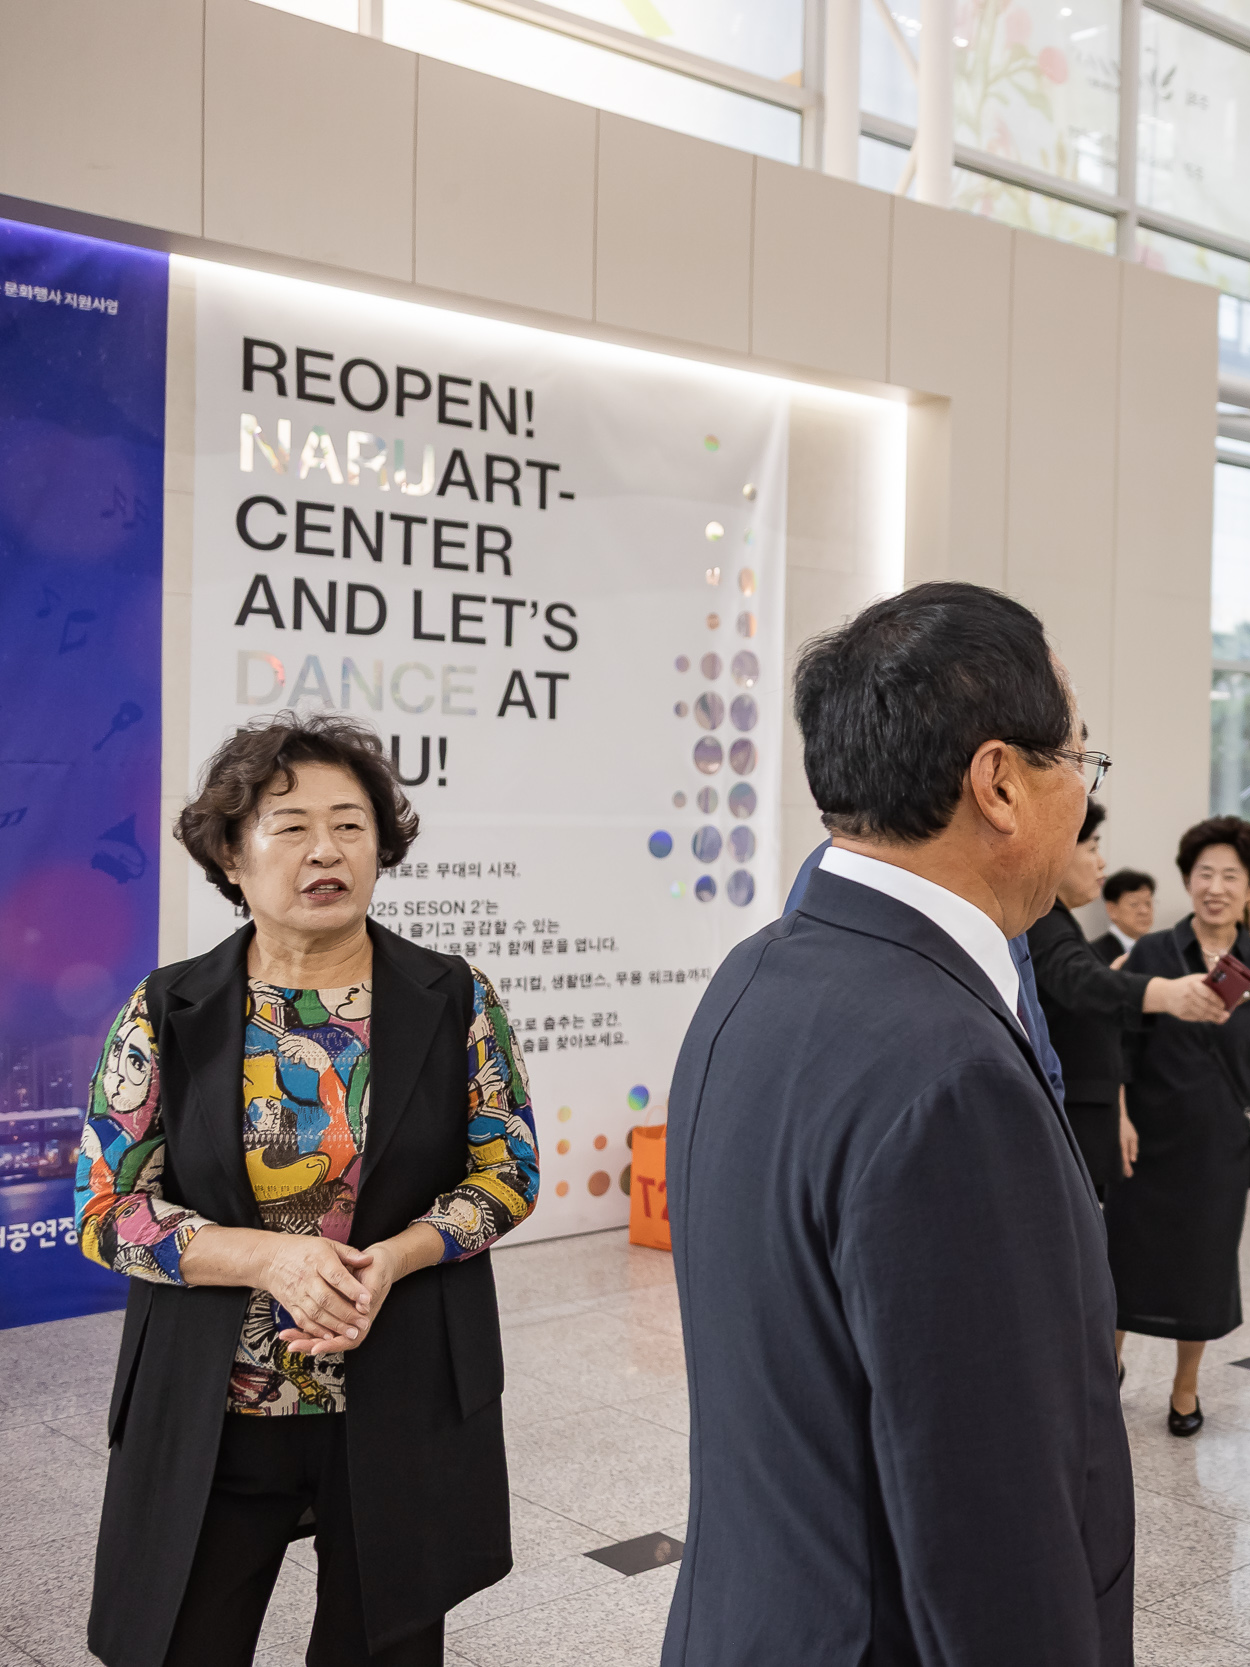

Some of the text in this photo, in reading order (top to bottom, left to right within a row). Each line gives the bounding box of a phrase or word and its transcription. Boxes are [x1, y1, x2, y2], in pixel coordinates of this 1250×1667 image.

[64, 291, 119, 316] 지원사업
[242, 336, 535, 438] REOPEN!
[236, 495, 513, 576] CENTER
[234, 573, 579, 652] AND LET'S
[235, 649, 570, 720] DANCE AT
[436, 861, 483, 879] 무대의
[487, 861, 522, 878] 시작.
[404, 899, 465, 916] SESON
[409, 921, 456, 938] 즐기고
[462, 919, 508, 937] 공감할
[513, 919, 527, 935] 수
[532, 917, 560, 934] 있는
[508, 938, 536, 956] 함께
[541, 937, 569, 954] 문을
[574, 936, 620, 953] 엽니다.
[551, 971, 611, 989] 생활댄스,
[615, 969, 642, 987] 무용
[511, 1017, 537, 1032] 으로
[543, 1014, 584, 1031] 춤추는
[523, 1031, 630, 1053] 춤을 찾아보세요.
